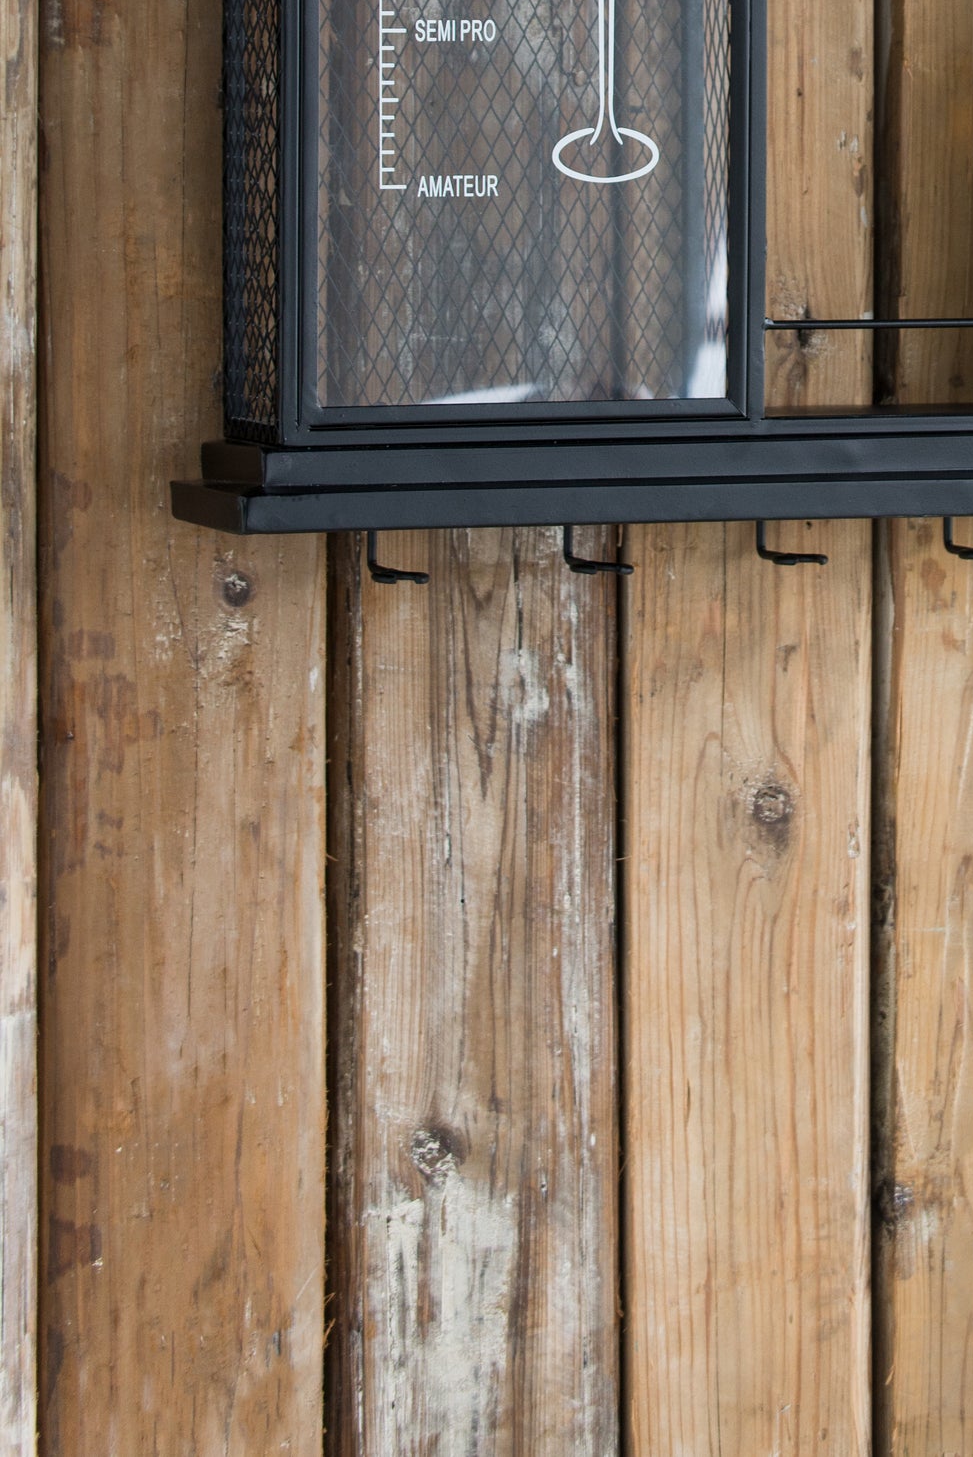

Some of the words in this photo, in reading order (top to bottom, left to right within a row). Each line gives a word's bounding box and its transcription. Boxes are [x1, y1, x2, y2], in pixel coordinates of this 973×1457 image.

[415, 19, 456, 42] SEMI
[460, 19, 496, 42] PRO
[417, 174, 499, 197] AMATEUR
